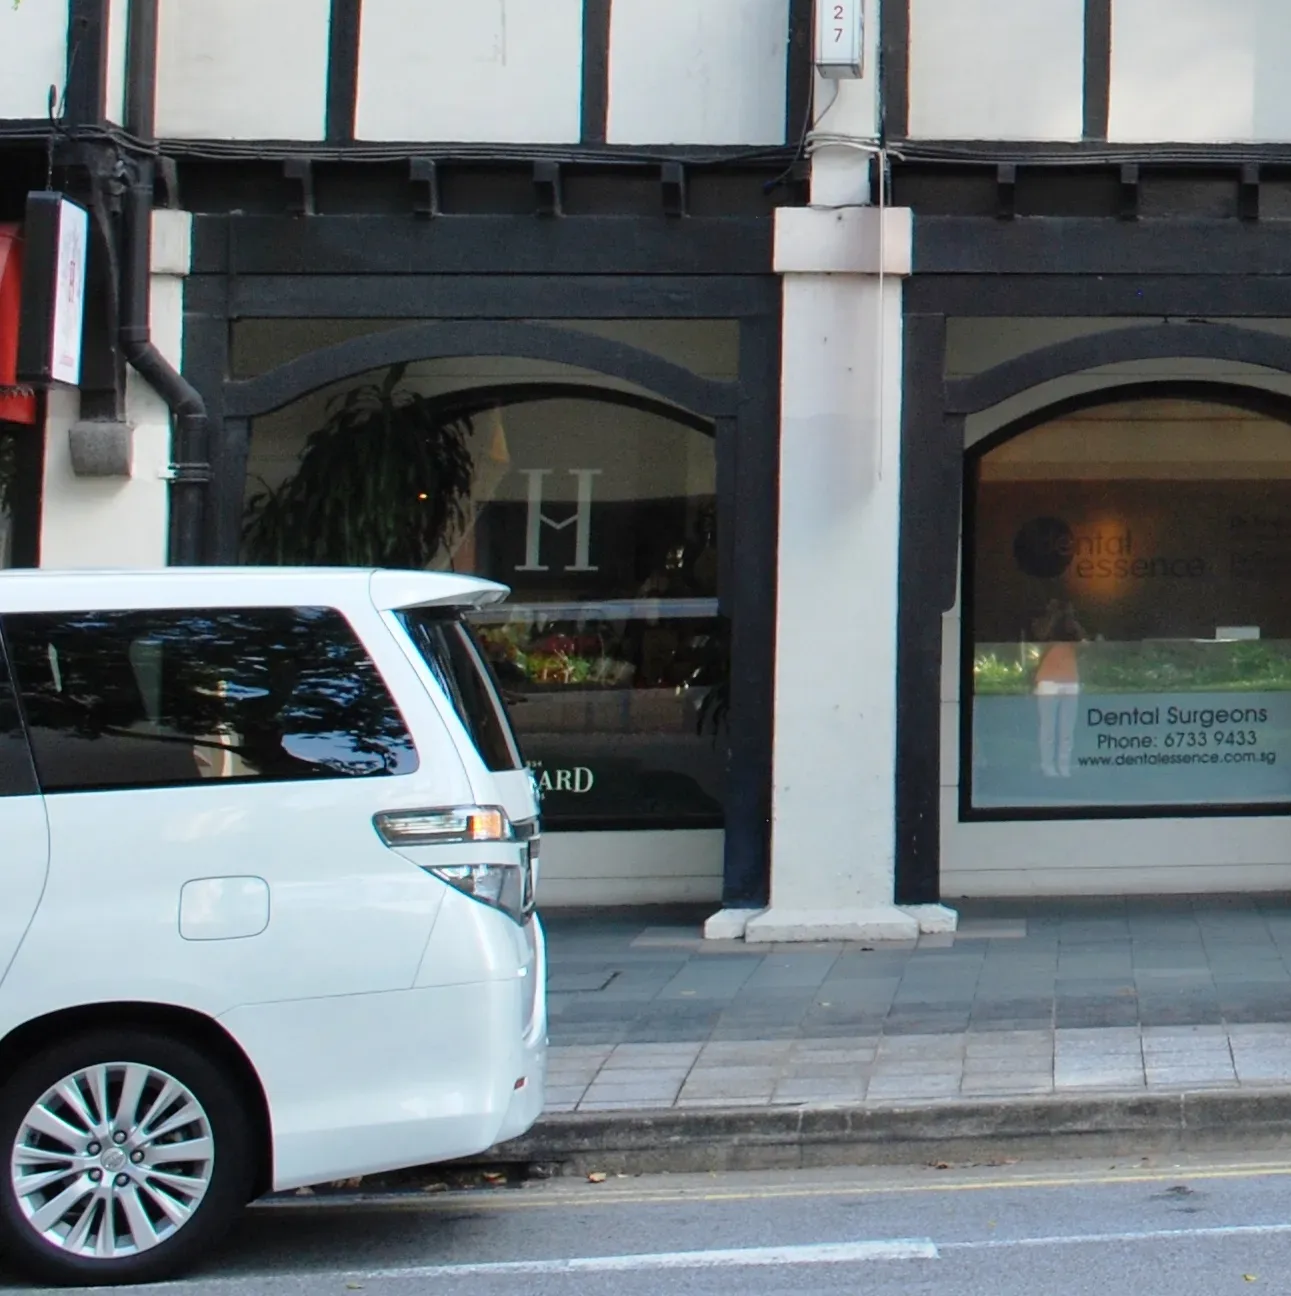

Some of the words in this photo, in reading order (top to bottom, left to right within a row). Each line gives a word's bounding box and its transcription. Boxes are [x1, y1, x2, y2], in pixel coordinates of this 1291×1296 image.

[1076, 556, 1206, 578] essence
[1087, 707, 1160, 727] Dental
[1166, 706, 1268, 728] Surgeons
[1097, 733, 1158, 750] Phone:
[1164, 731, 1208, 748] 6733
[1213, 730, 1258, 746] 9433
[1078, 751, 1277, 766] www.dentalessence.com.sg
